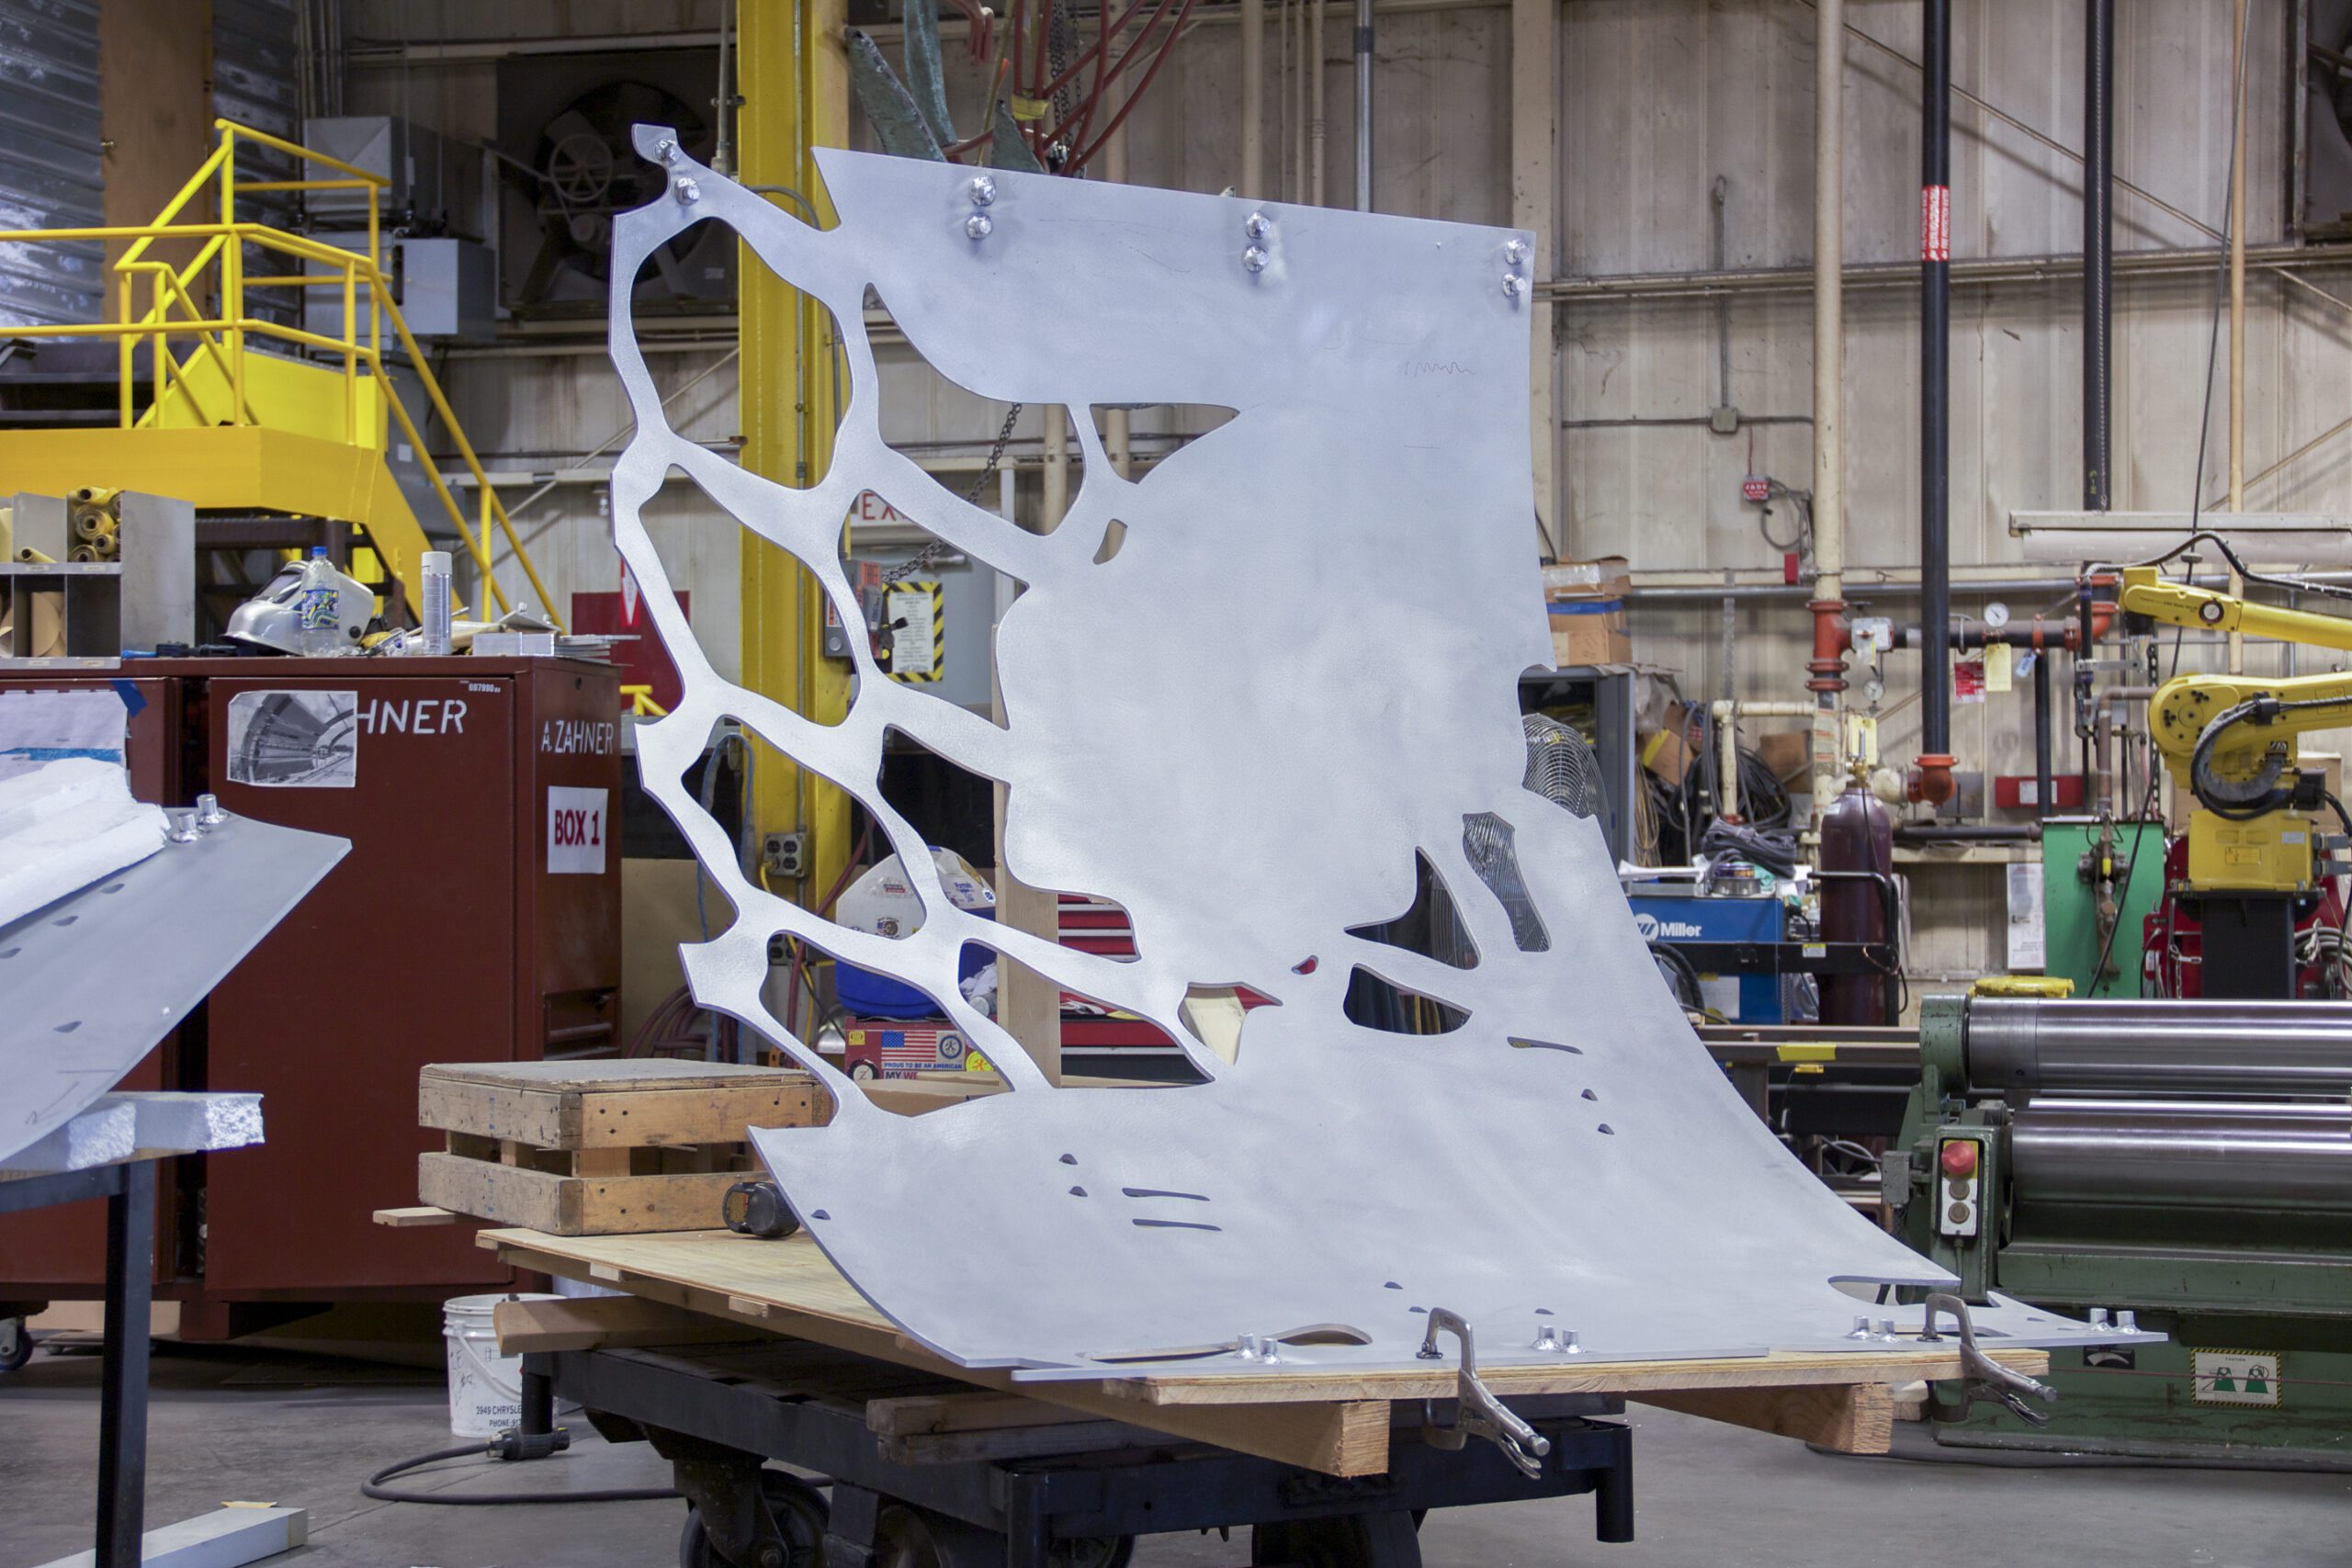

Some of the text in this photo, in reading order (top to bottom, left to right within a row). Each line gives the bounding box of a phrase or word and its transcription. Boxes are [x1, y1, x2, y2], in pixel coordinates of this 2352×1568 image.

[862, 491, 905, 522] EX
[356, 698, 468, 734] HNER
[554, 719, 615, 755] ZAHNER
[554, 808, 601, 846] BOX 1
[1659, 921, 1703, 937] Miller
[885, 1071, 901, 1079] MY
[492, 1404, 522, 1416] CHRYSLE
